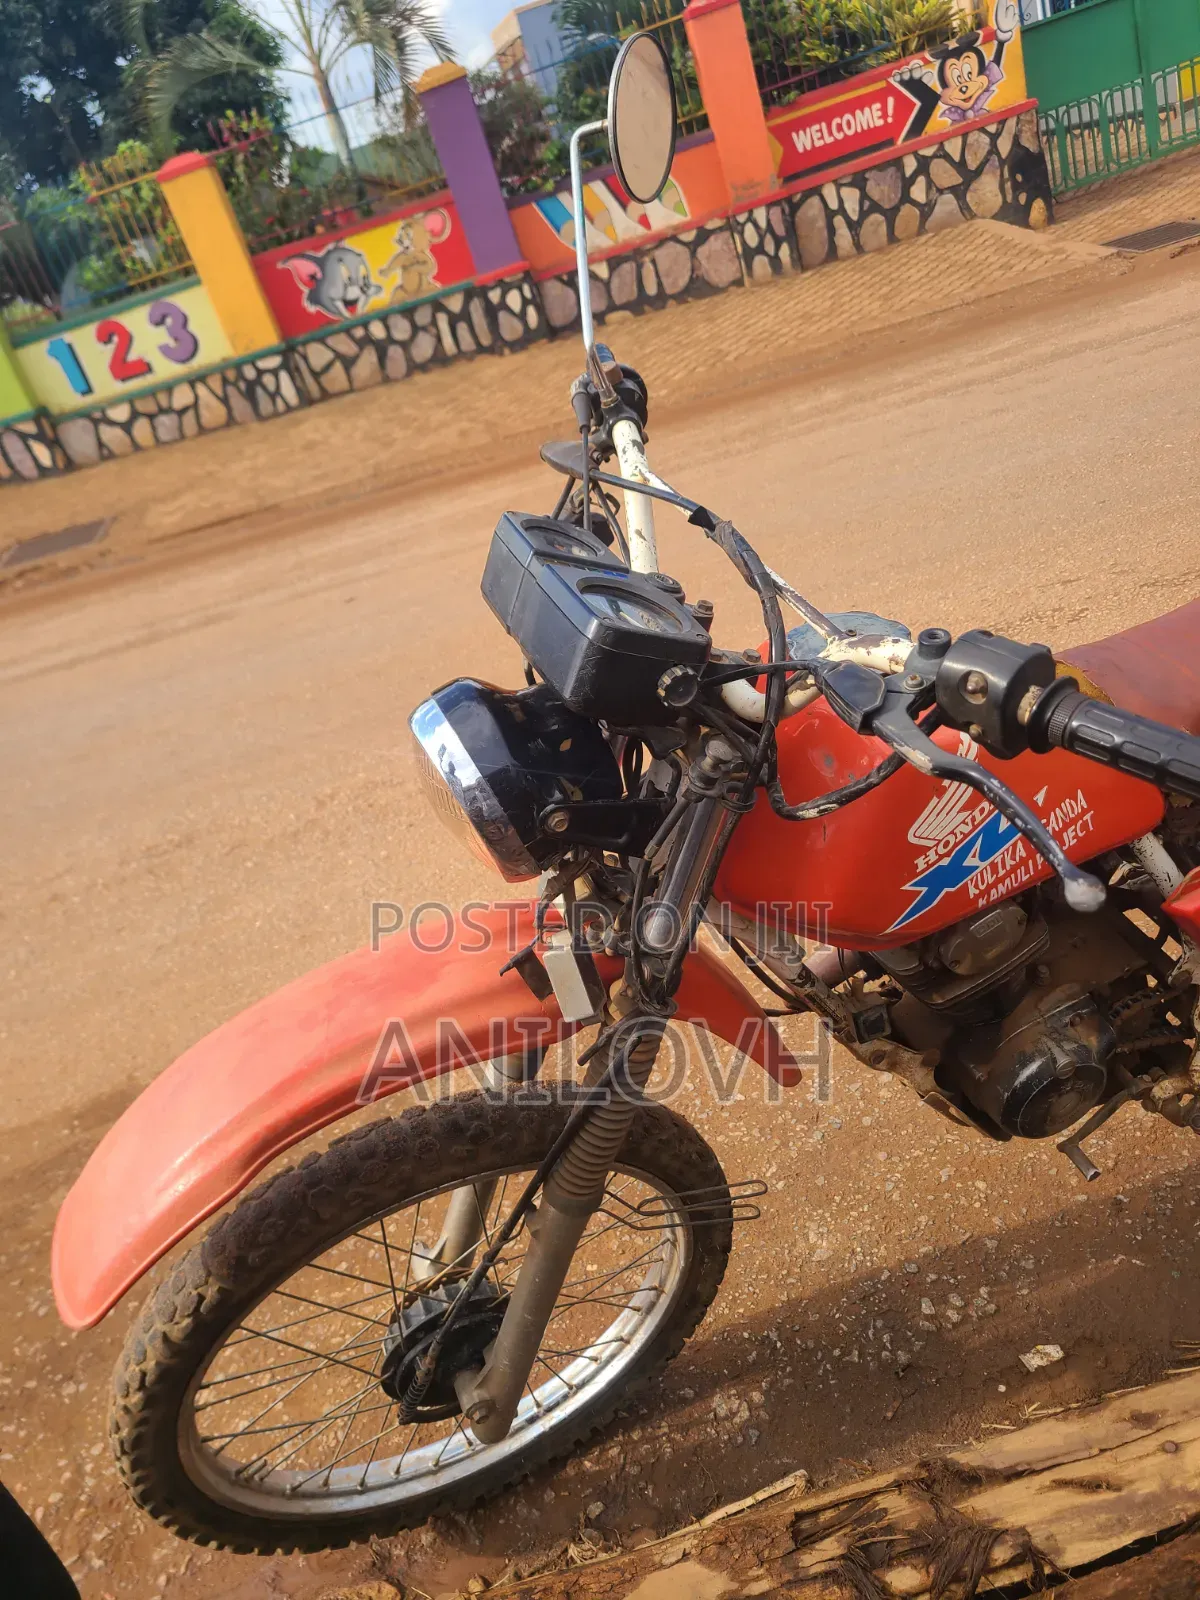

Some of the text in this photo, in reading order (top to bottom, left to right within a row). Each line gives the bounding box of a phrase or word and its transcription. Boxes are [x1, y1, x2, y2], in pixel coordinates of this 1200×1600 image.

[913, 798, 998, 873] HOND
[966, 840, 1027, 899] KULIKA
[978, 810, 1095, 909] KAMULI PJECT
